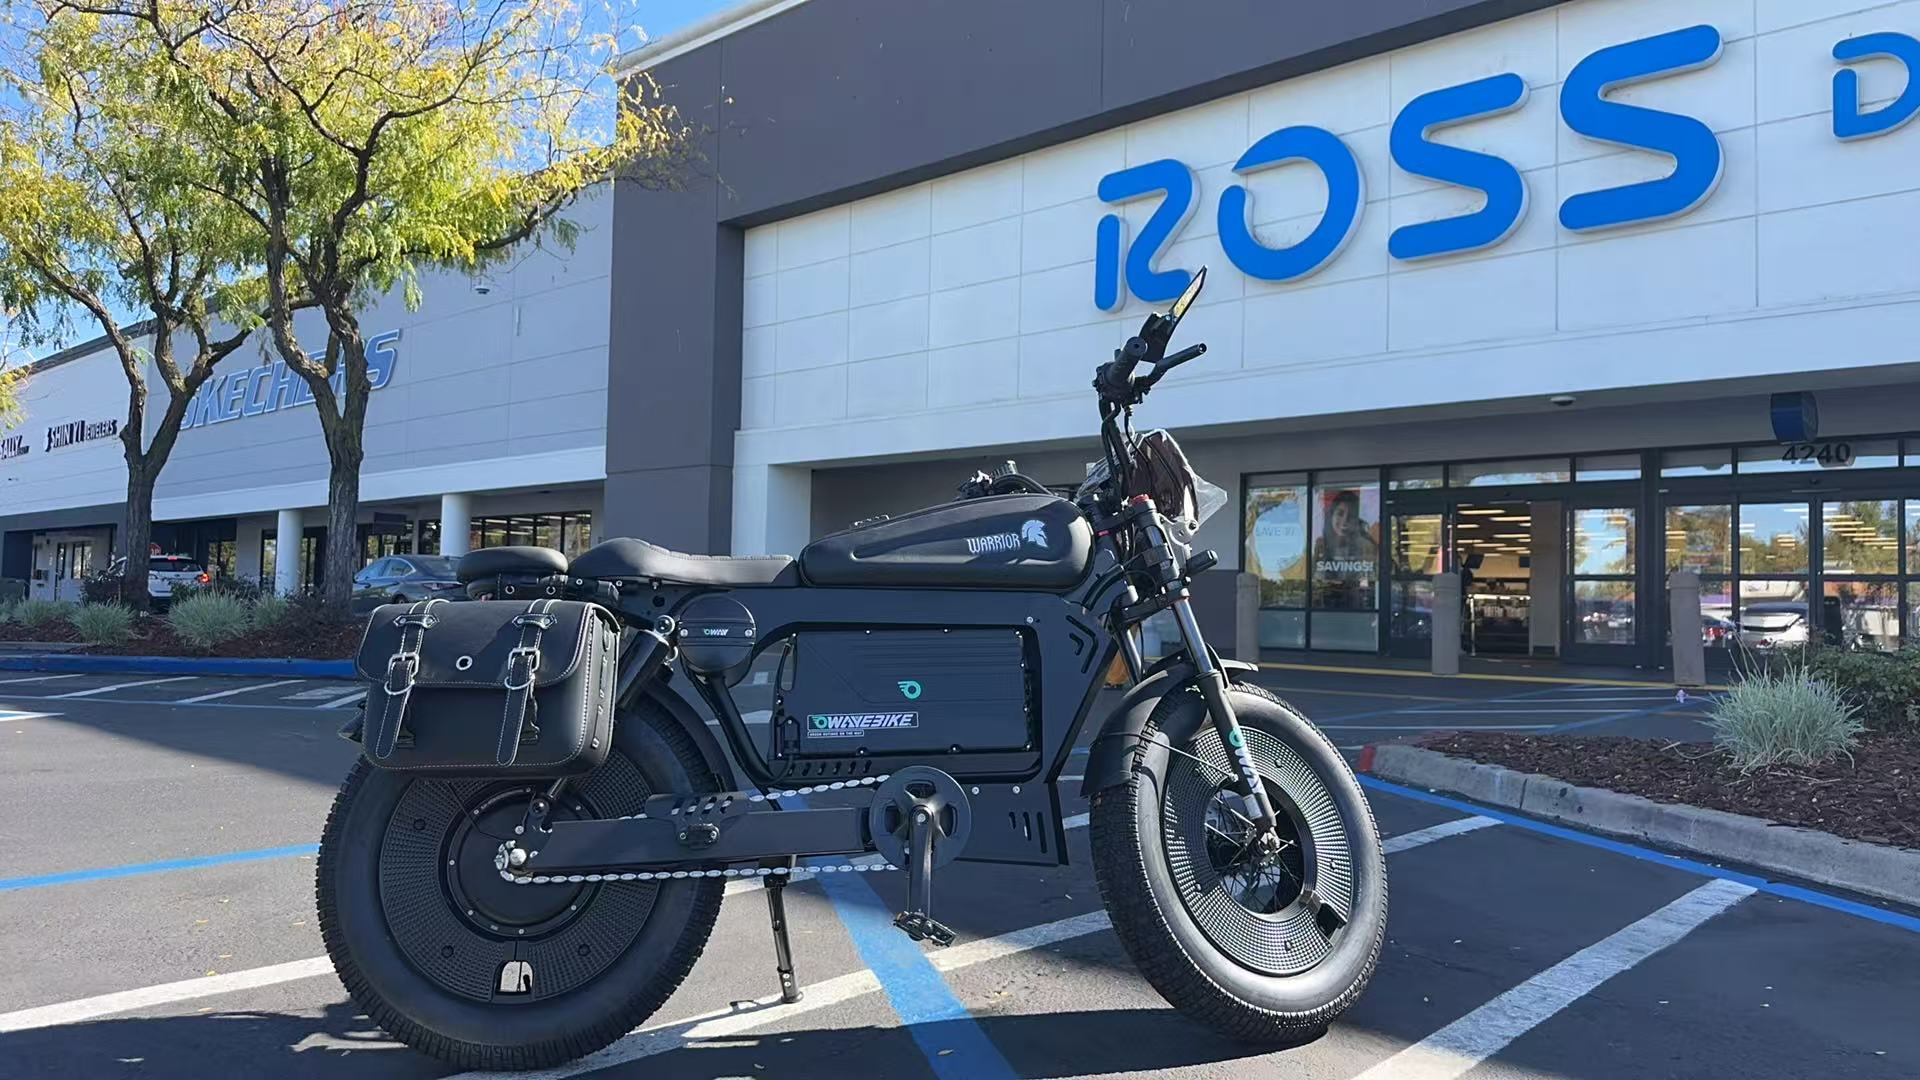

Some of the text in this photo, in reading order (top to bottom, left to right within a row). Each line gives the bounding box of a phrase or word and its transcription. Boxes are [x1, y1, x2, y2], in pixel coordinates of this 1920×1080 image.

[1094, 23, 1723, 313] ROSS
[51, 423, 74, 449] SHIN
[73, 420, 86, 443] YI
[1781, 442, 1852, 464] 4240
[966, 533, 1021, 554] WARRIOR
[1316, 560, 1374, 572] SAVINGS!
